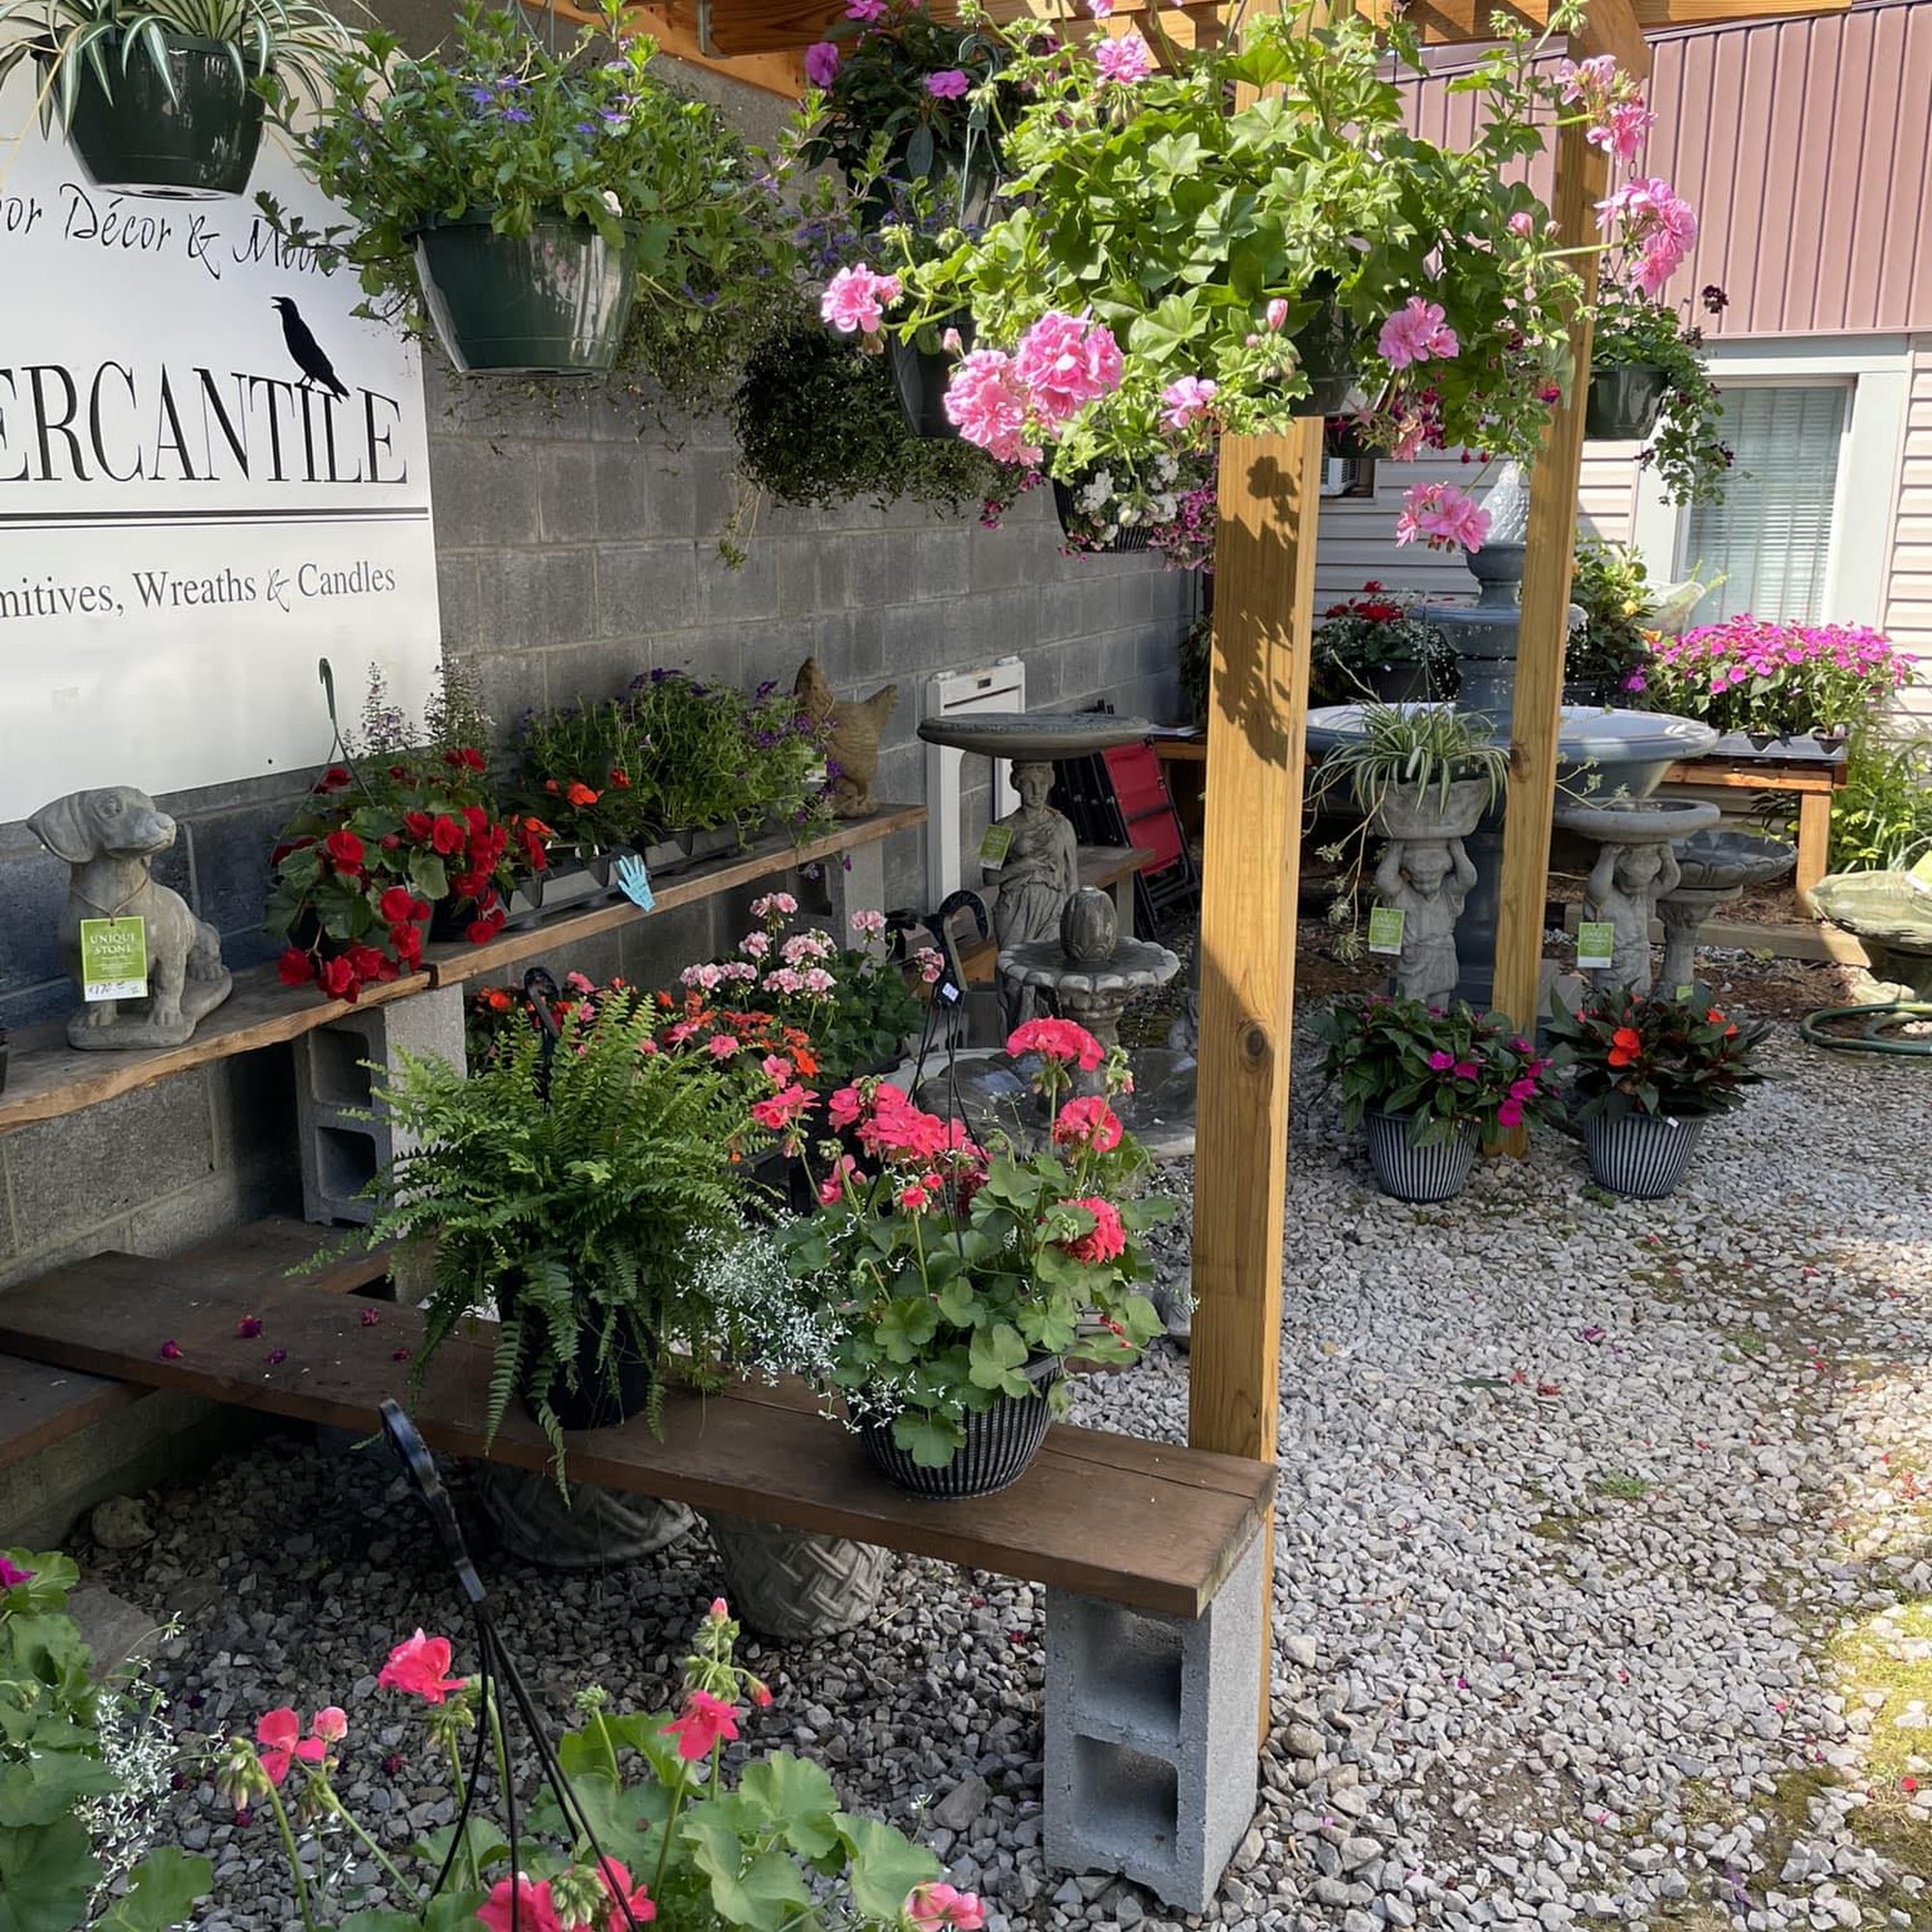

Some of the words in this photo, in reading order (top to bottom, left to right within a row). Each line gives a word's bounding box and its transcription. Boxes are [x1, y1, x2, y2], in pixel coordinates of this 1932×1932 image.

[59, 183, 172, 251] Décor
[187, 213, 221, 281] &
[131, 567, 257, 609] Wreaths
[267, 568, 291, 612] &
[298, 559, 396, 597] Candles
